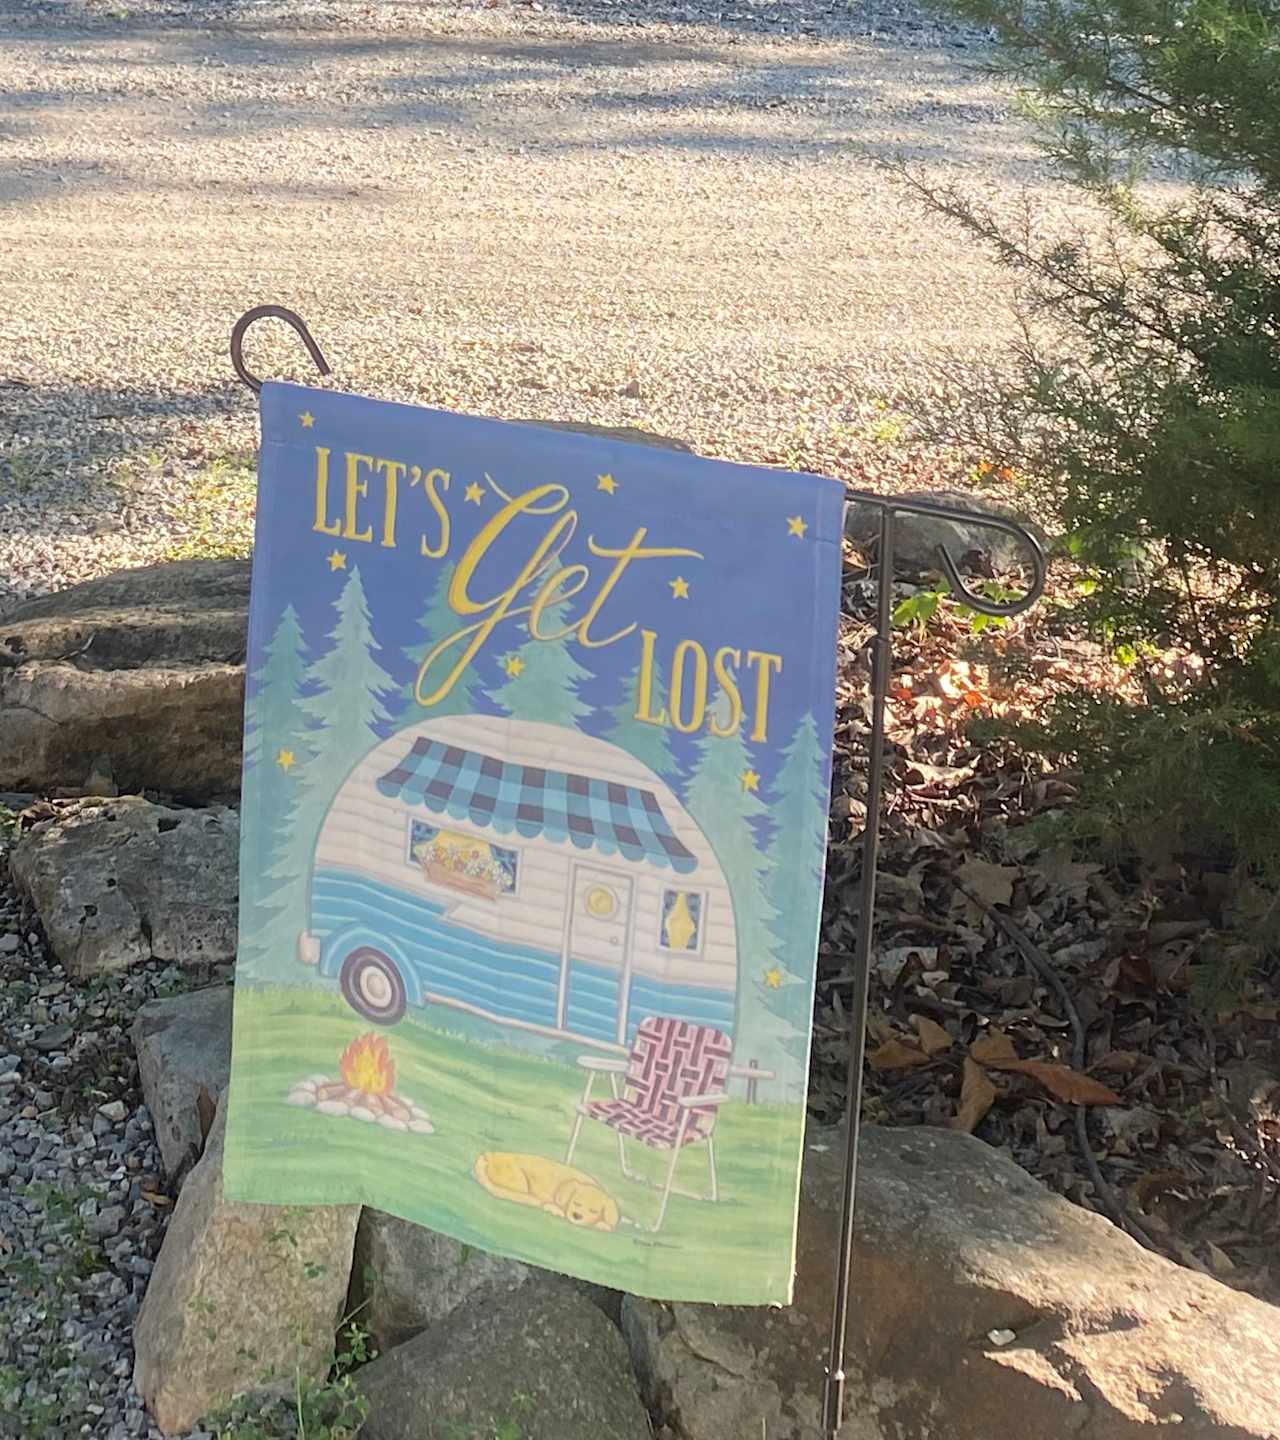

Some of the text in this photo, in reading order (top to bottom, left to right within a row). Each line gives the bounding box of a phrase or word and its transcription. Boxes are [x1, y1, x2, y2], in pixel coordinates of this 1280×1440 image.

[313, 447, 450, 558] LET'S
[415, 472, 704, 706] Get
[634, 629, 782, 743] LOST
